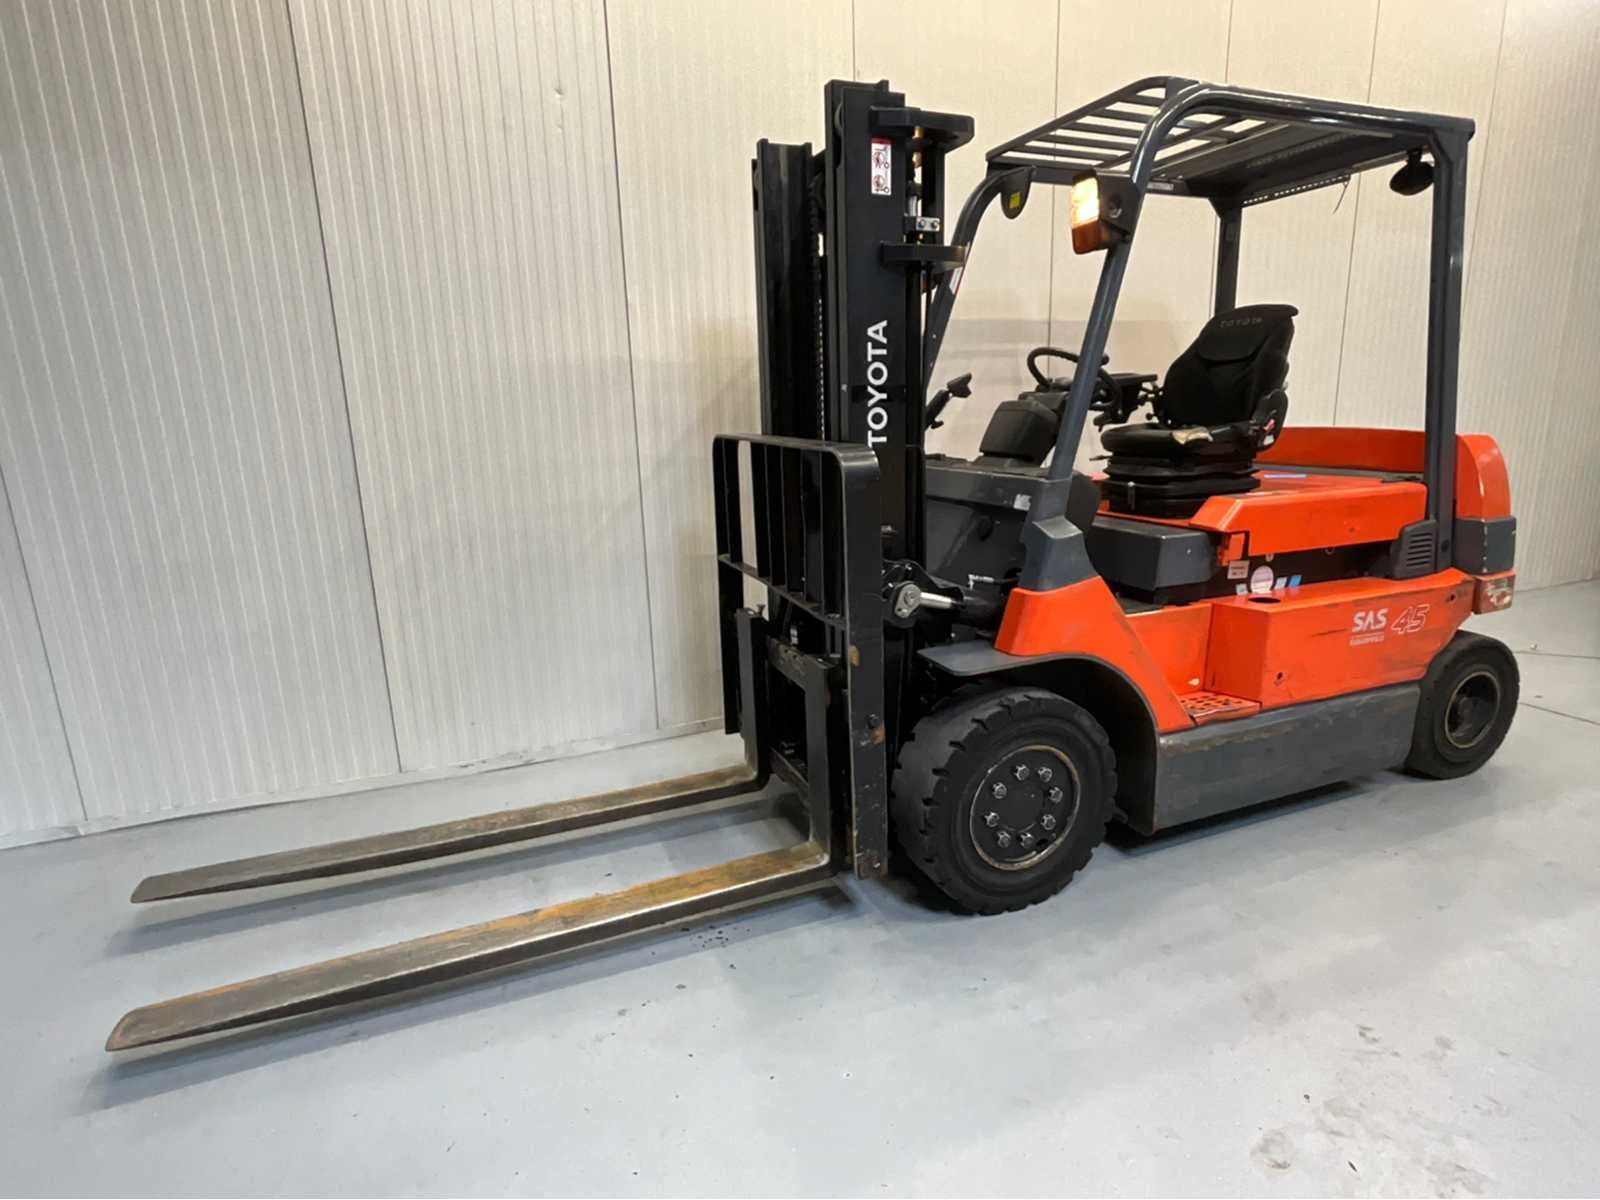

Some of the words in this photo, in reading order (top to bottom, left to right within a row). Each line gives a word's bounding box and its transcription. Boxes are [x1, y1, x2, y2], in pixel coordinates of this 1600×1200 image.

[867, 320, 888, 448] TOYOTA
[1351, 608, 1388, 632] SAS
[1391, 603, 1430, 634] 45
